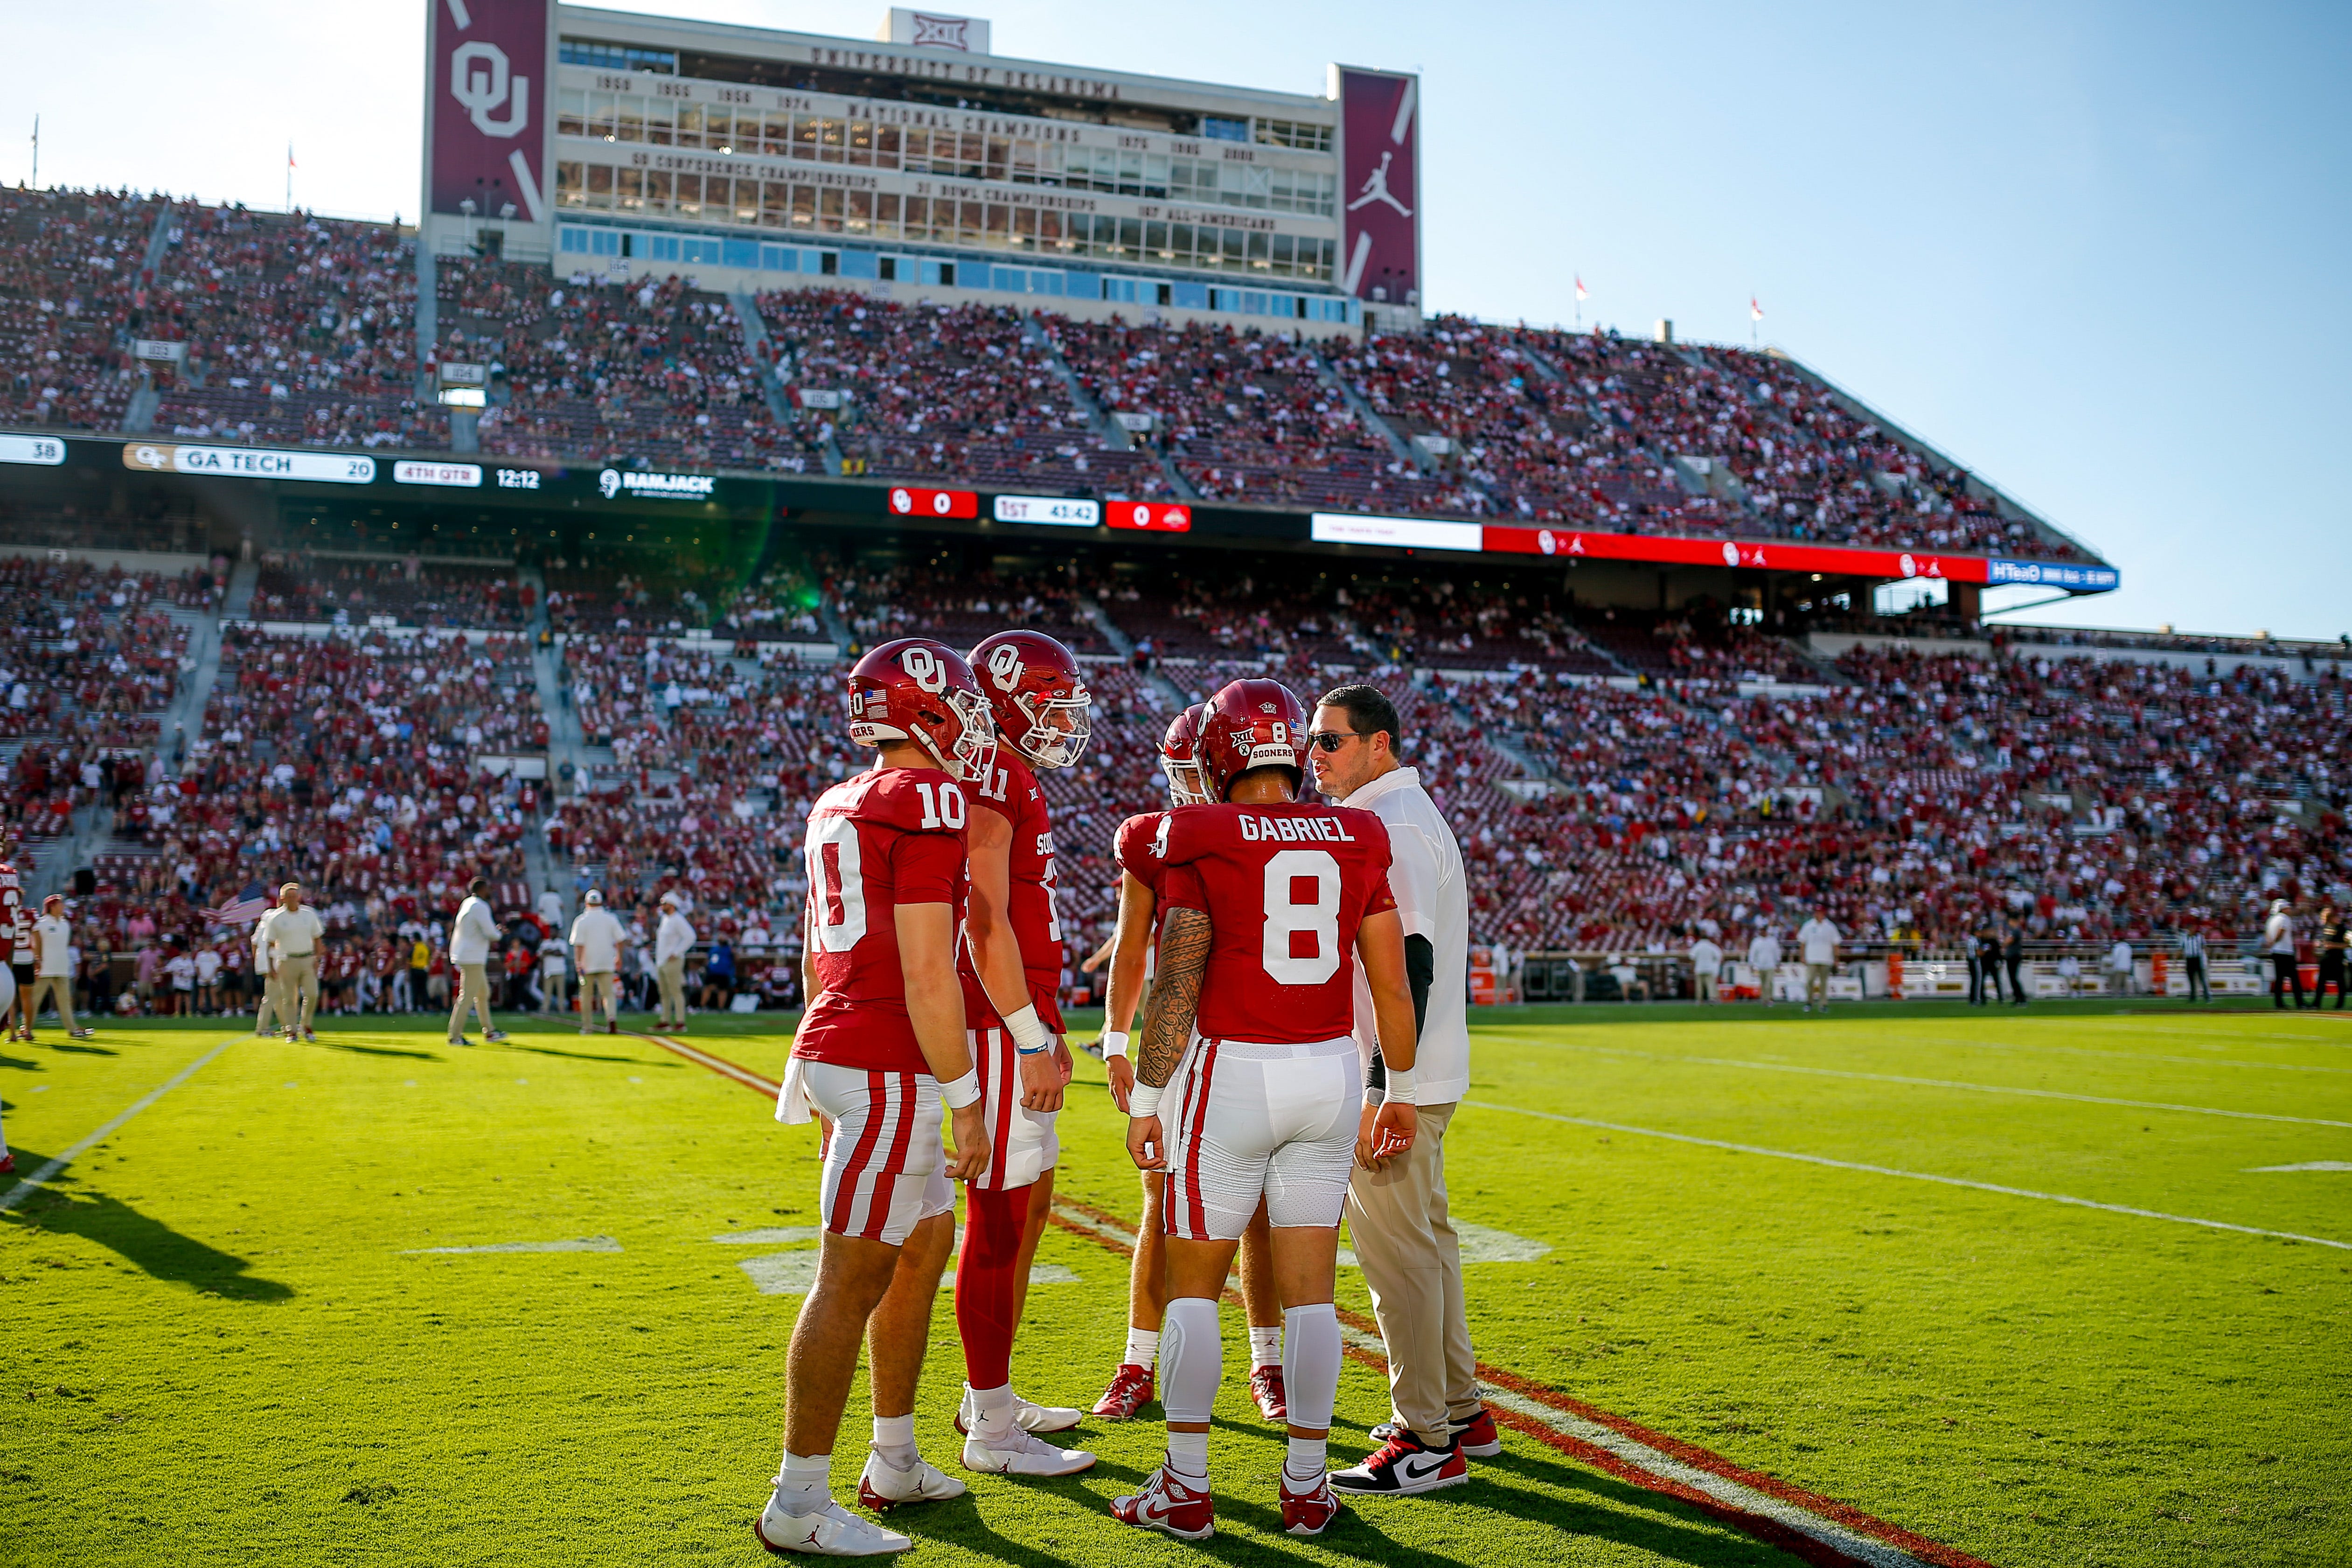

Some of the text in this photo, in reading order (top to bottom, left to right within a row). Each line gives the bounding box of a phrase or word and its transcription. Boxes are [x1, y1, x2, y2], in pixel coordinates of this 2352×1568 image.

[811, 48, 1120, 98] UNIVERSITY OF OKLAHOMA
[451, 40, 529, 138] OU
[778, 96, 811, 111] 1974
[848, 104, 952, 128] NATIONAL
[963, 116, 1080, 142] CHAMPIONS
[655, 155, 757, 177] CONFERENCE
[758, 163, 878, 188] CHAMPIONSHIPS
[940, 184, 978, 199] BOWL
[985, 189, 1097, 211] CHAMPIONSHIPS
[1168, 208, 1276, 230] ALL-AMERICANS
[33, 441, 56, 459] 38
[187, 451, 221, 467] GA
[230, 453, 291, 472] TECH
[347, 461, 370, 477] 20
[405, 467, 471, 481] 4TH QTR
[496, 468, 541, 489] 12:12
[933, 492, 951, 515] 0
[1002, 501, 1028, 517] 1ST
[1133, 505, 1150, 526] 0
[1992, 562, 2041, 582] HTeaO
[901, 648, 947, 693] OU
[988, 644, 1024, 691] OU
[851, 725, 875, 738] NERS
[1272, 722, 1287, 743] 8
[1253, 749, 1293, 759] SOONERS
[980, 763, 1008, 802] 11
[916, 782, 965, 829] 10
[1238, 814, 1355, 842] GABRIEL
[1037, 831, 1055, 856] SOO
[1263, 850, 1342, 985] 8
